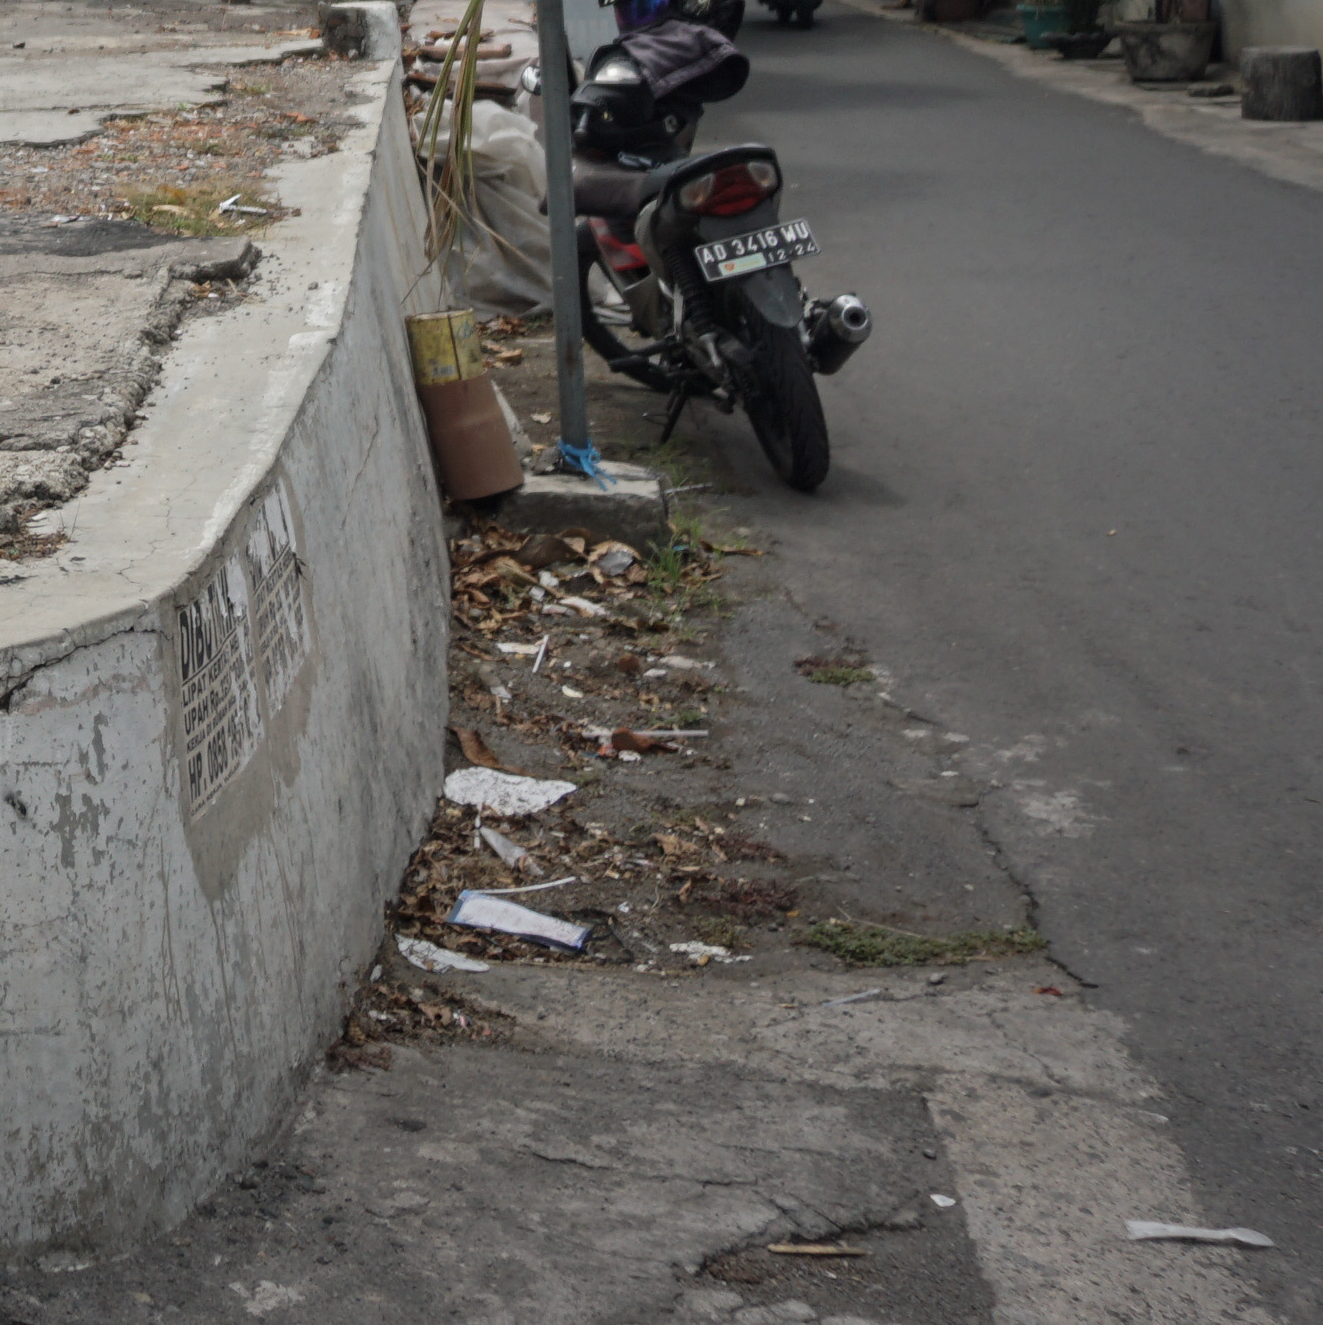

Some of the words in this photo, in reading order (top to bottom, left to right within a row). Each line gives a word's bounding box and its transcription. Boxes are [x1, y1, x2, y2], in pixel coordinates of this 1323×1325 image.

[702, 243, 727, 264] AD
[732, 230, 778, 256] 3416
[780, 221, 809, 244] WU
[182, 667, 207, 711] LIPAT
[183, 690, 209, 739] UPAH
